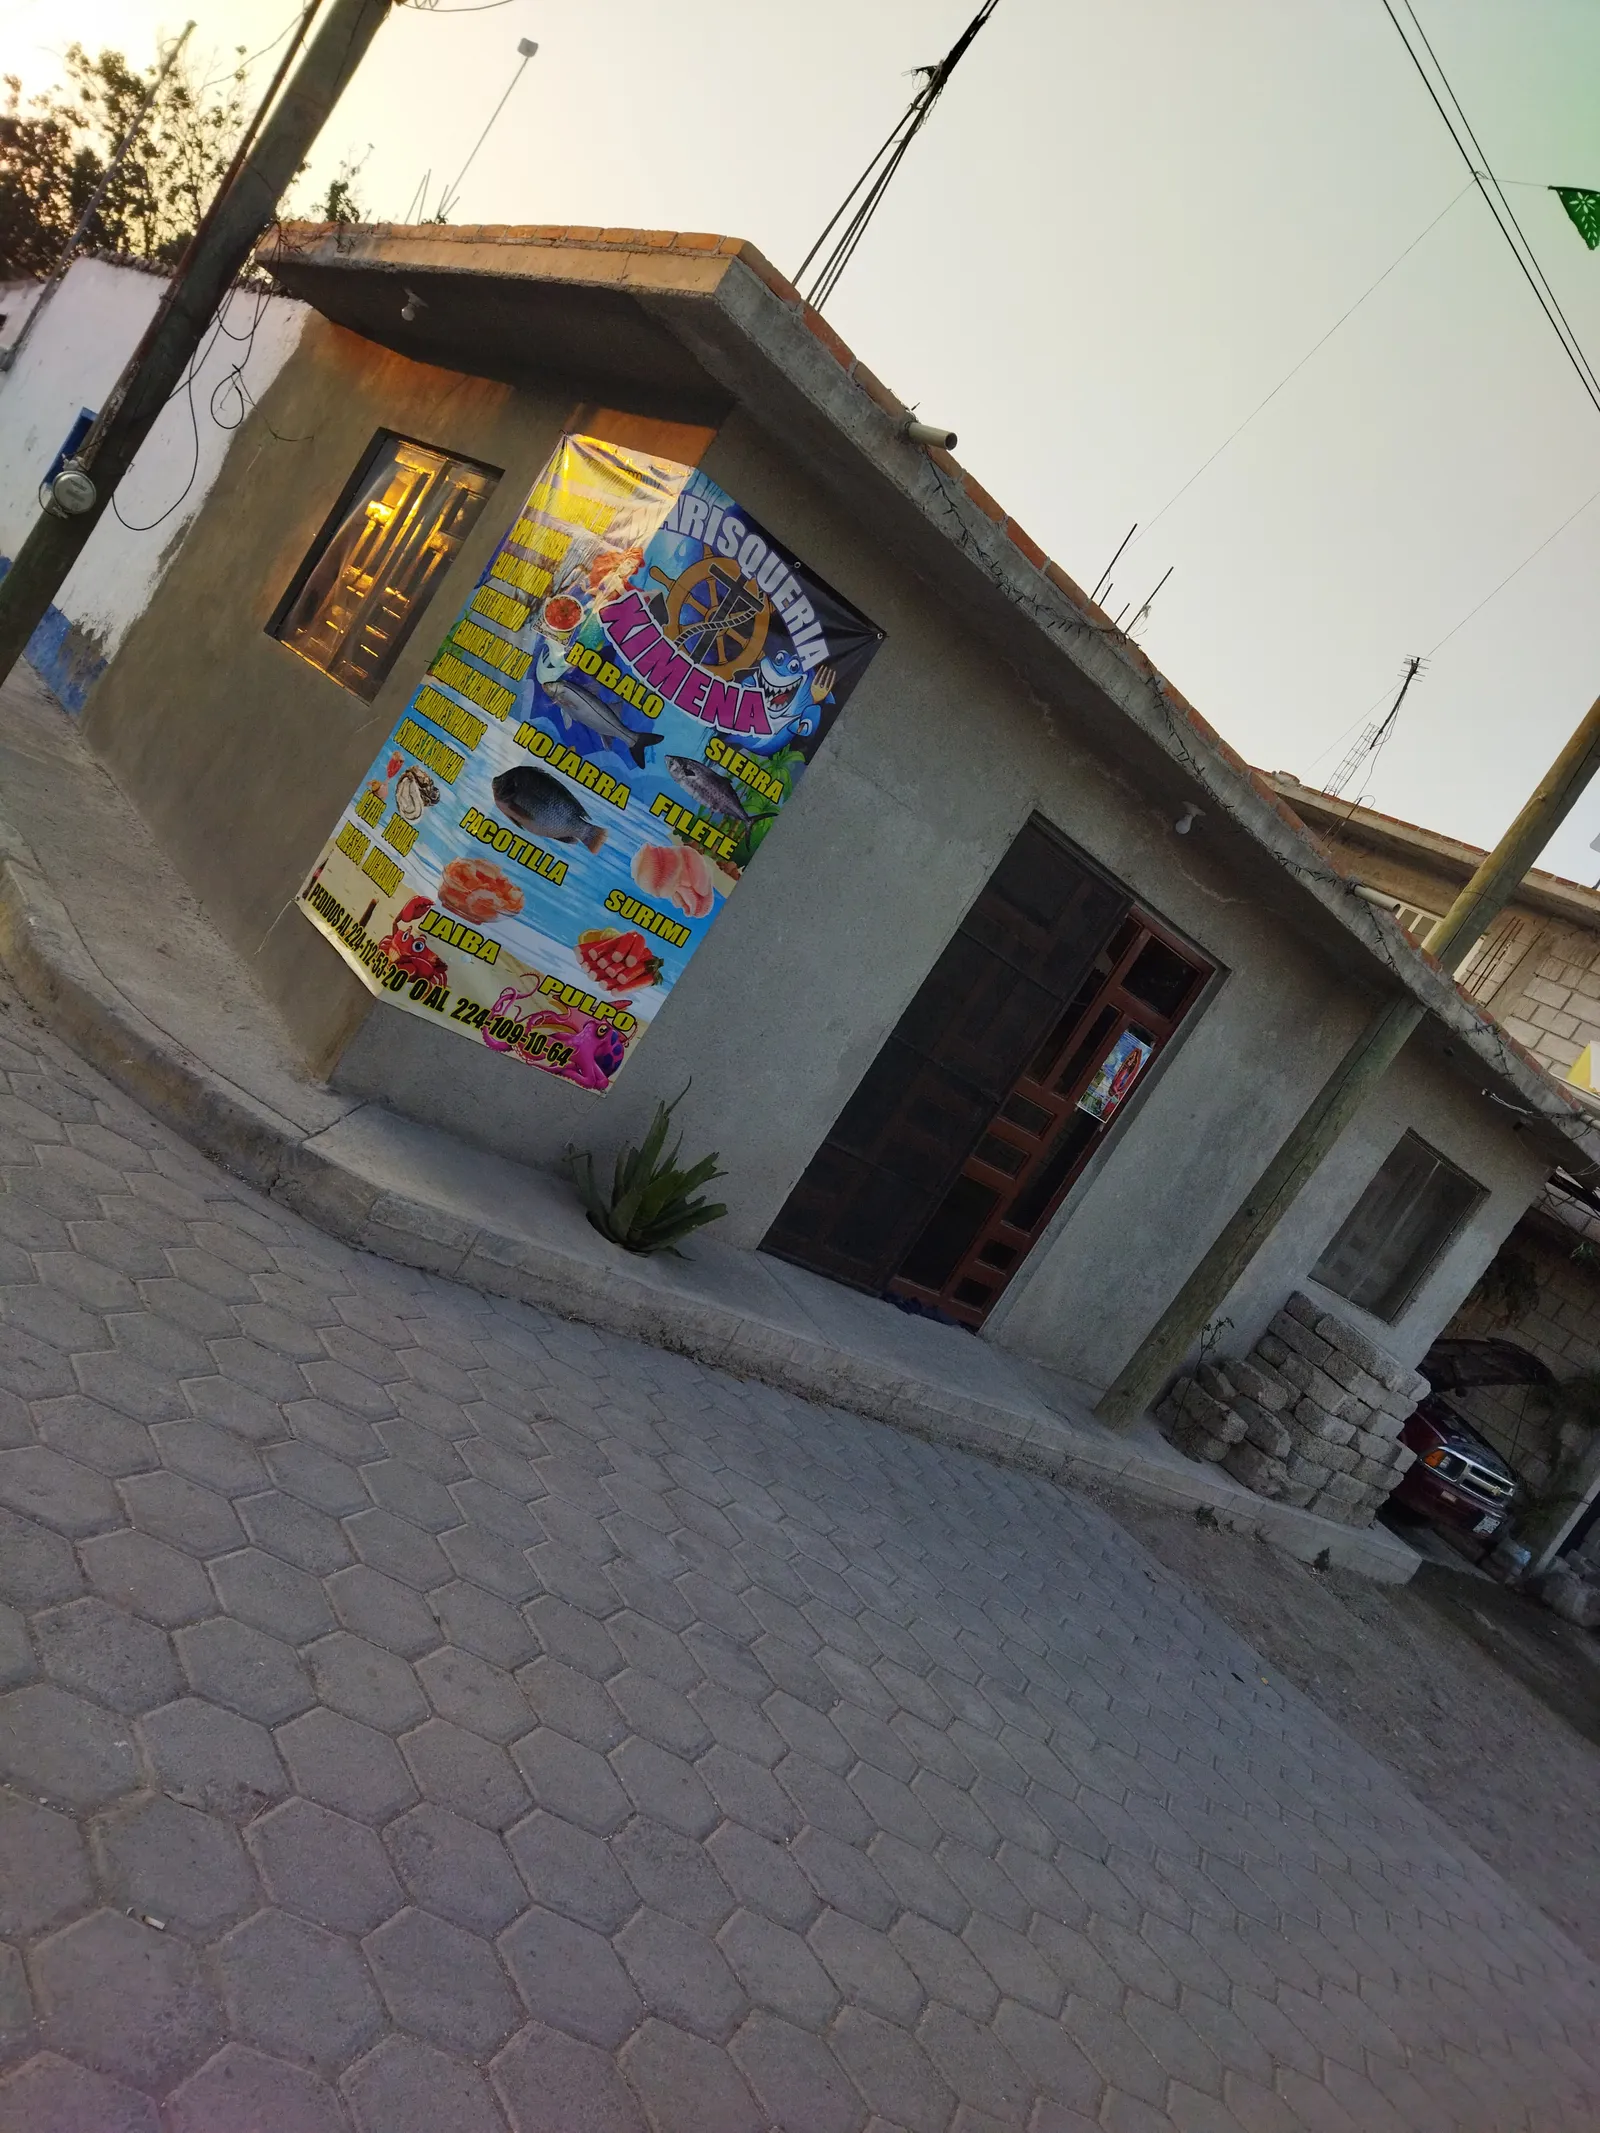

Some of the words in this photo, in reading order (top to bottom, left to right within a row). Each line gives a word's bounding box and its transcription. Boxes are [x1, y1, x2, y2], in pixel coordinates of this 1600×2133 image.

[487, 550, 519, 583] CALDO
[468, 583, 498, 616] FILETE
[450, 617, 496, 659] CAMARONES
[600, 592, 774, 734] XIMENA
[430, 650, 475, 693] CAMARONES
[568, 646, 665, 719] ROBALO
[412, 683, 456, 728] CAMARONES
[392, 716, 429, 757] OSTIONES
[514, 723, 631, 809] MOJARRA
[705, 737, 784, 802] SIERRA
[380, 810, 420, 858] TOSTADAS
[461, 807, 568, 886] PACOTILLA
[651, 793, 739, 860] FILETE
[418, 911, 501, 965] JAIBA
[605, 889, 690, 948] SURIMI
[307, 881, 346, 930] PEDIDOS
[334, 910, 354, 939] AL
[348, 920, 405, 992] 224-112-53-20
[423, 983, 449, 1012] AL
[450, 997, 574, 1067] 224-109-10-64
[539, 975, 637, 1034] PULPO
